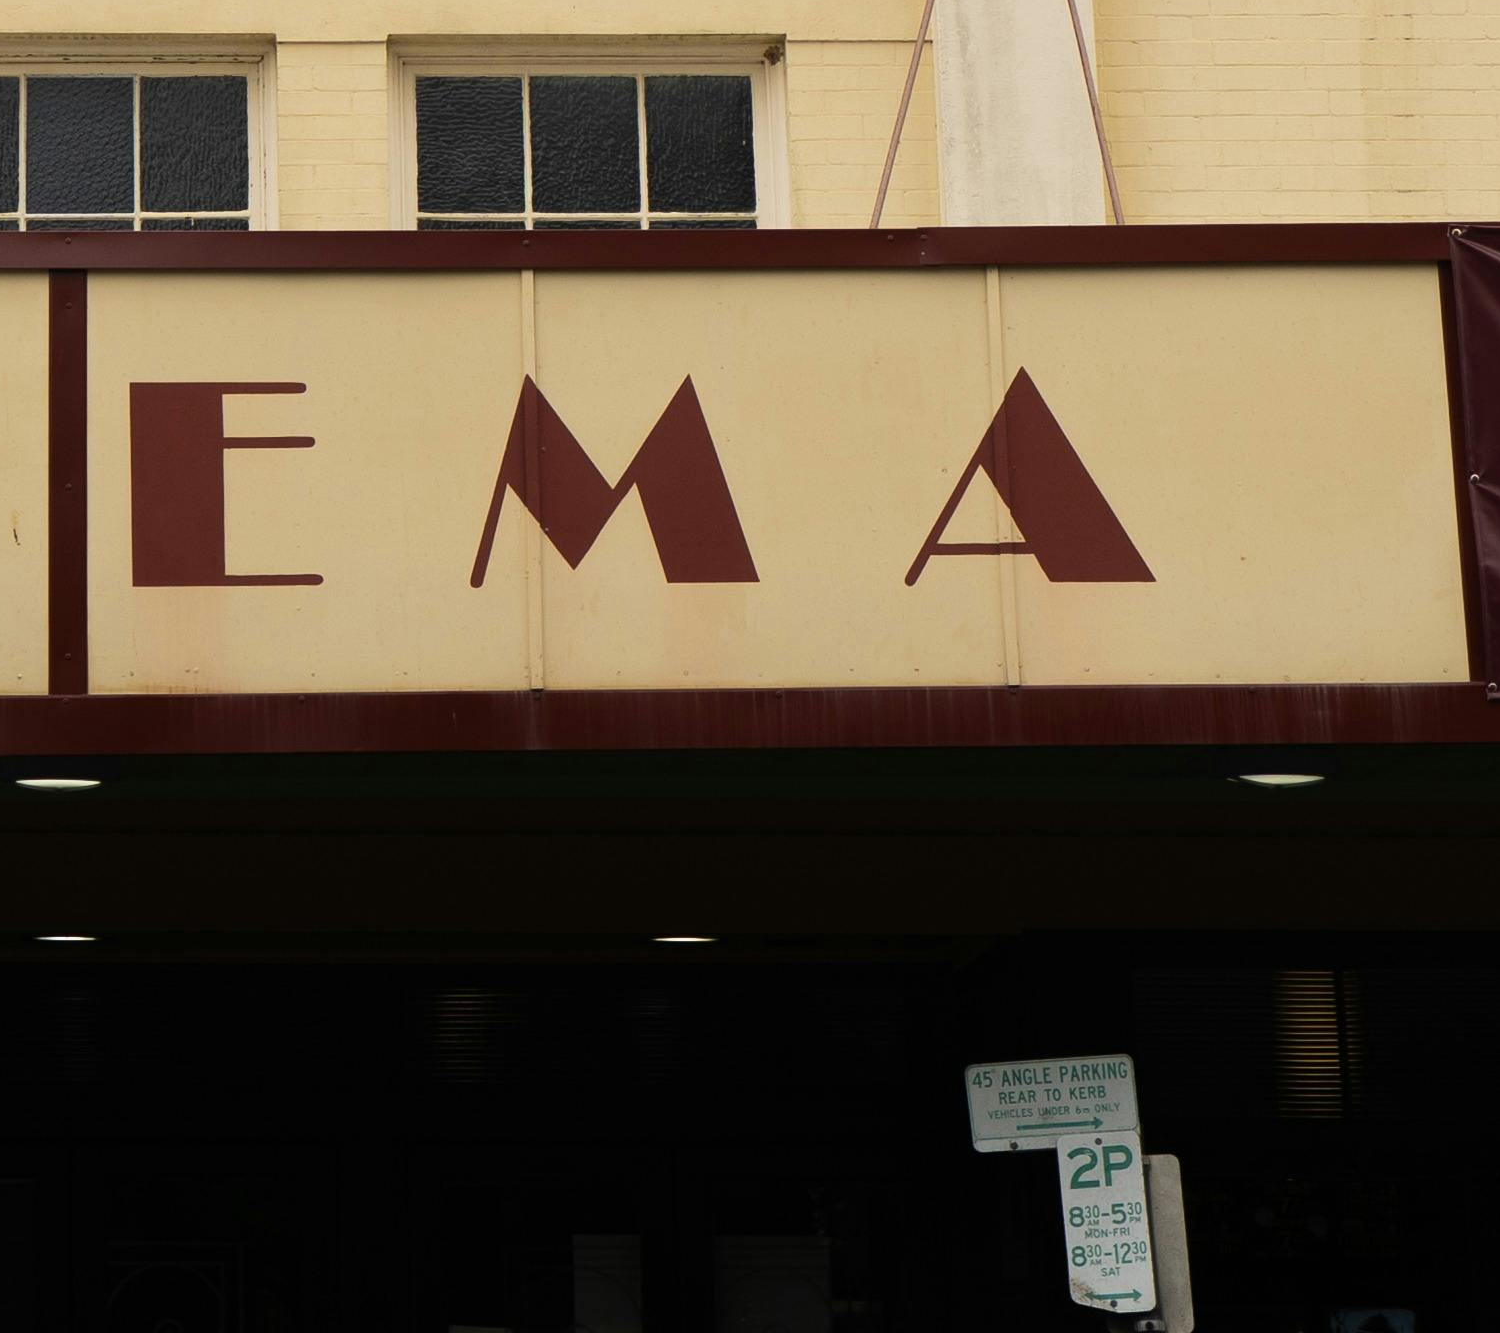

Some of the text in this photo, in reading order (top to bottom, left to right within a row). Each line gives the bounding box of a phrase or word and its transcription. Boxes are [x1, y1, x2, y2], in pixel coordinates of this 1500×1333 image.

[1001, 1067, 1053, 1088] ANGLE
[1059, 1061, 1128, 1083] PARKING
[999, 1085, 1107, 1105] REAR TO KERB
[987, 1102, 1121, 1120] VEHICLES UNDER 6m ONLY
[1066, 1144, 1133, 1189] 2P
[1084, 1227, 1131, 1240] MON-FRI
[1100, 1266, 1121, 1277] SAT
